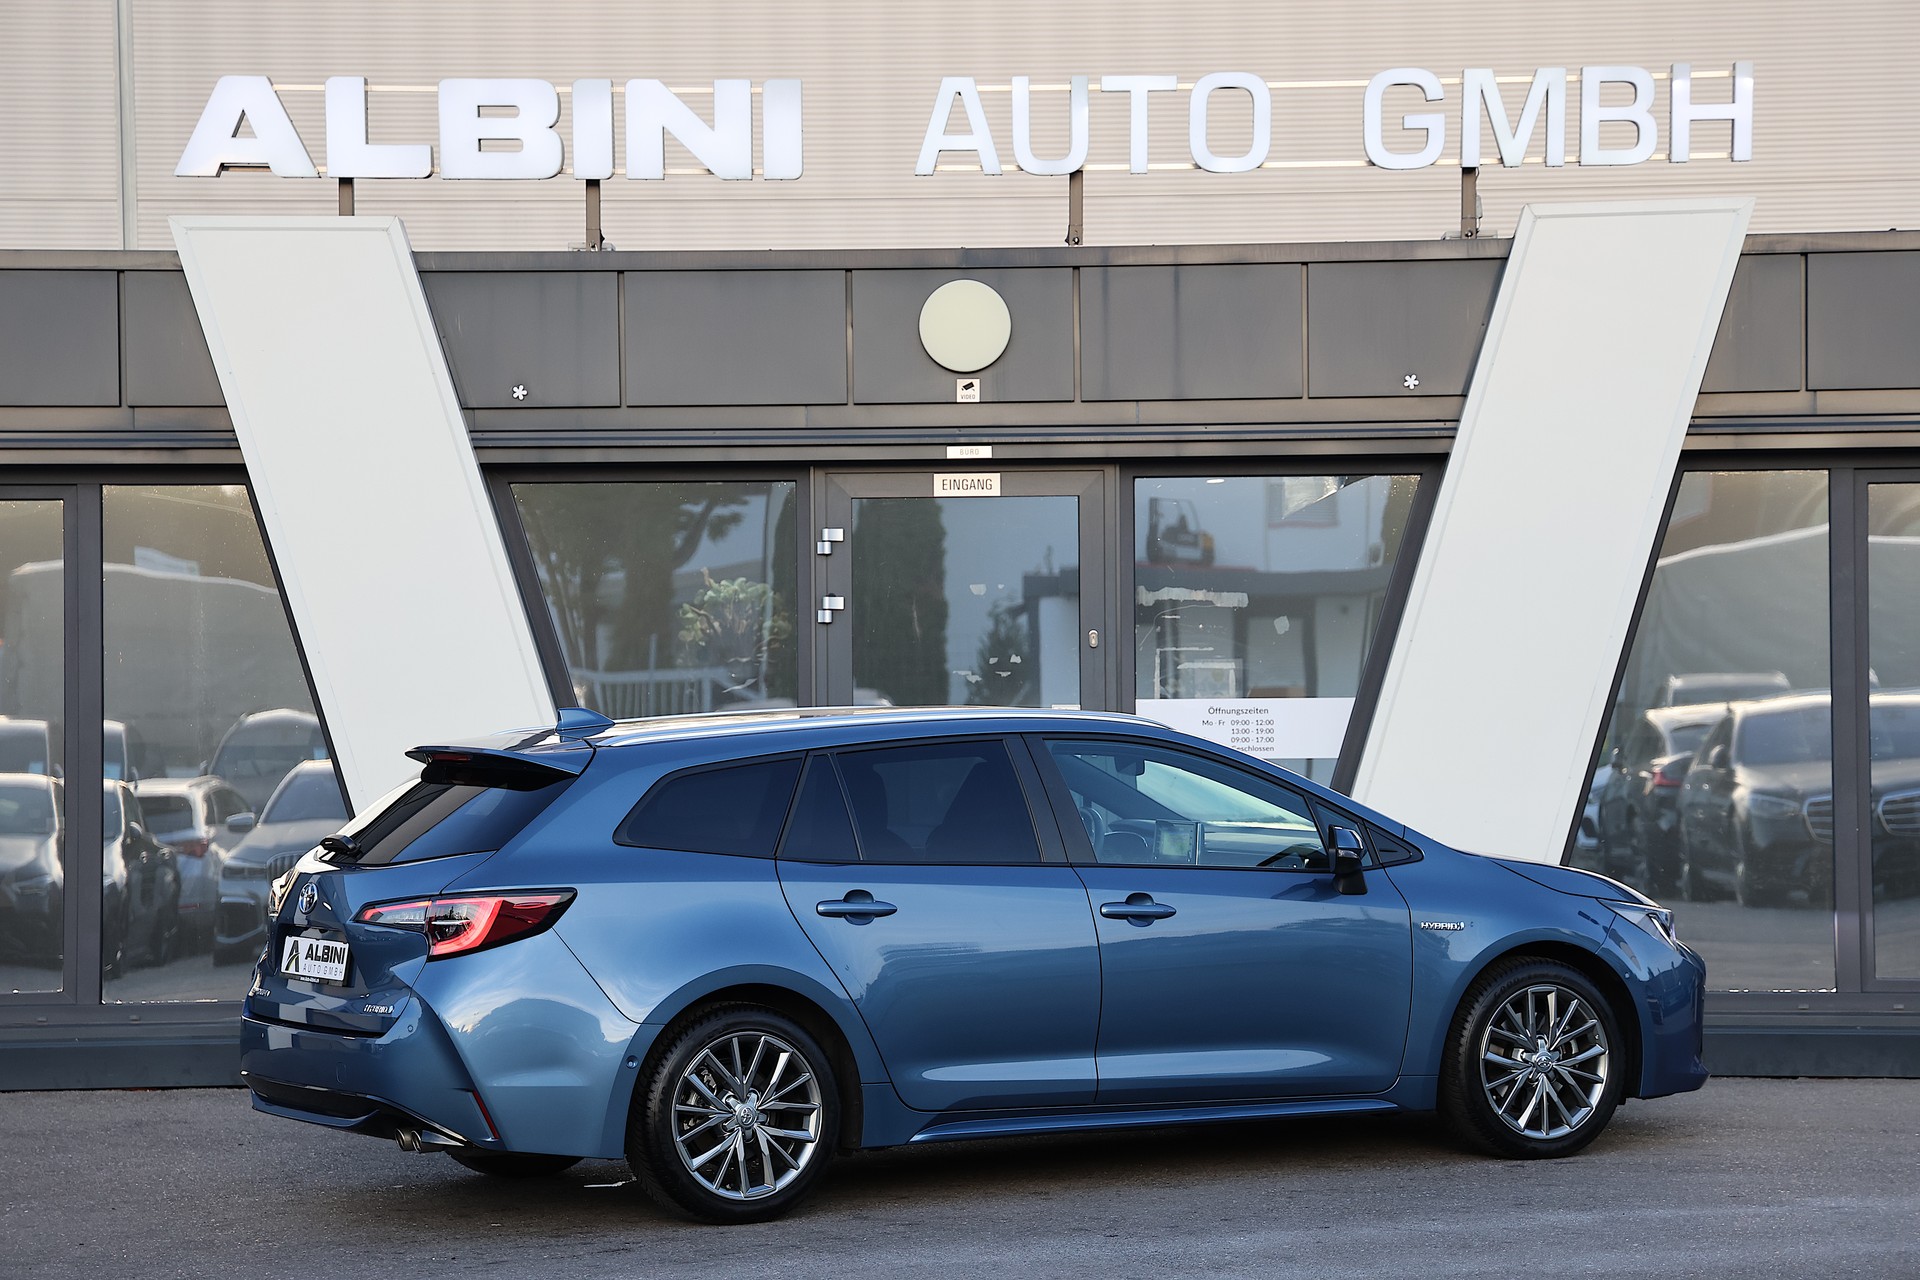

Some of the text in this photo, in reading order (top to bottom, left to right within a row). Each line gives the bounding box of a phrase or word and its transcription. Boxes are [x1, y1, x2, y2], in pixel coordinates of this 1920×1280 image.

[174, 62, 1755, 181] ALBINI AUTO GMBH
[942, 478, 993, 491] EINGANG
[1208, 706, 1269, 716] Öffnungszeiten
[1420, 921, 1458, 930] HYBRID
[304, 943, 346, 965] ALBINI
[303, 963, 343, 977] AUTO GMBH
